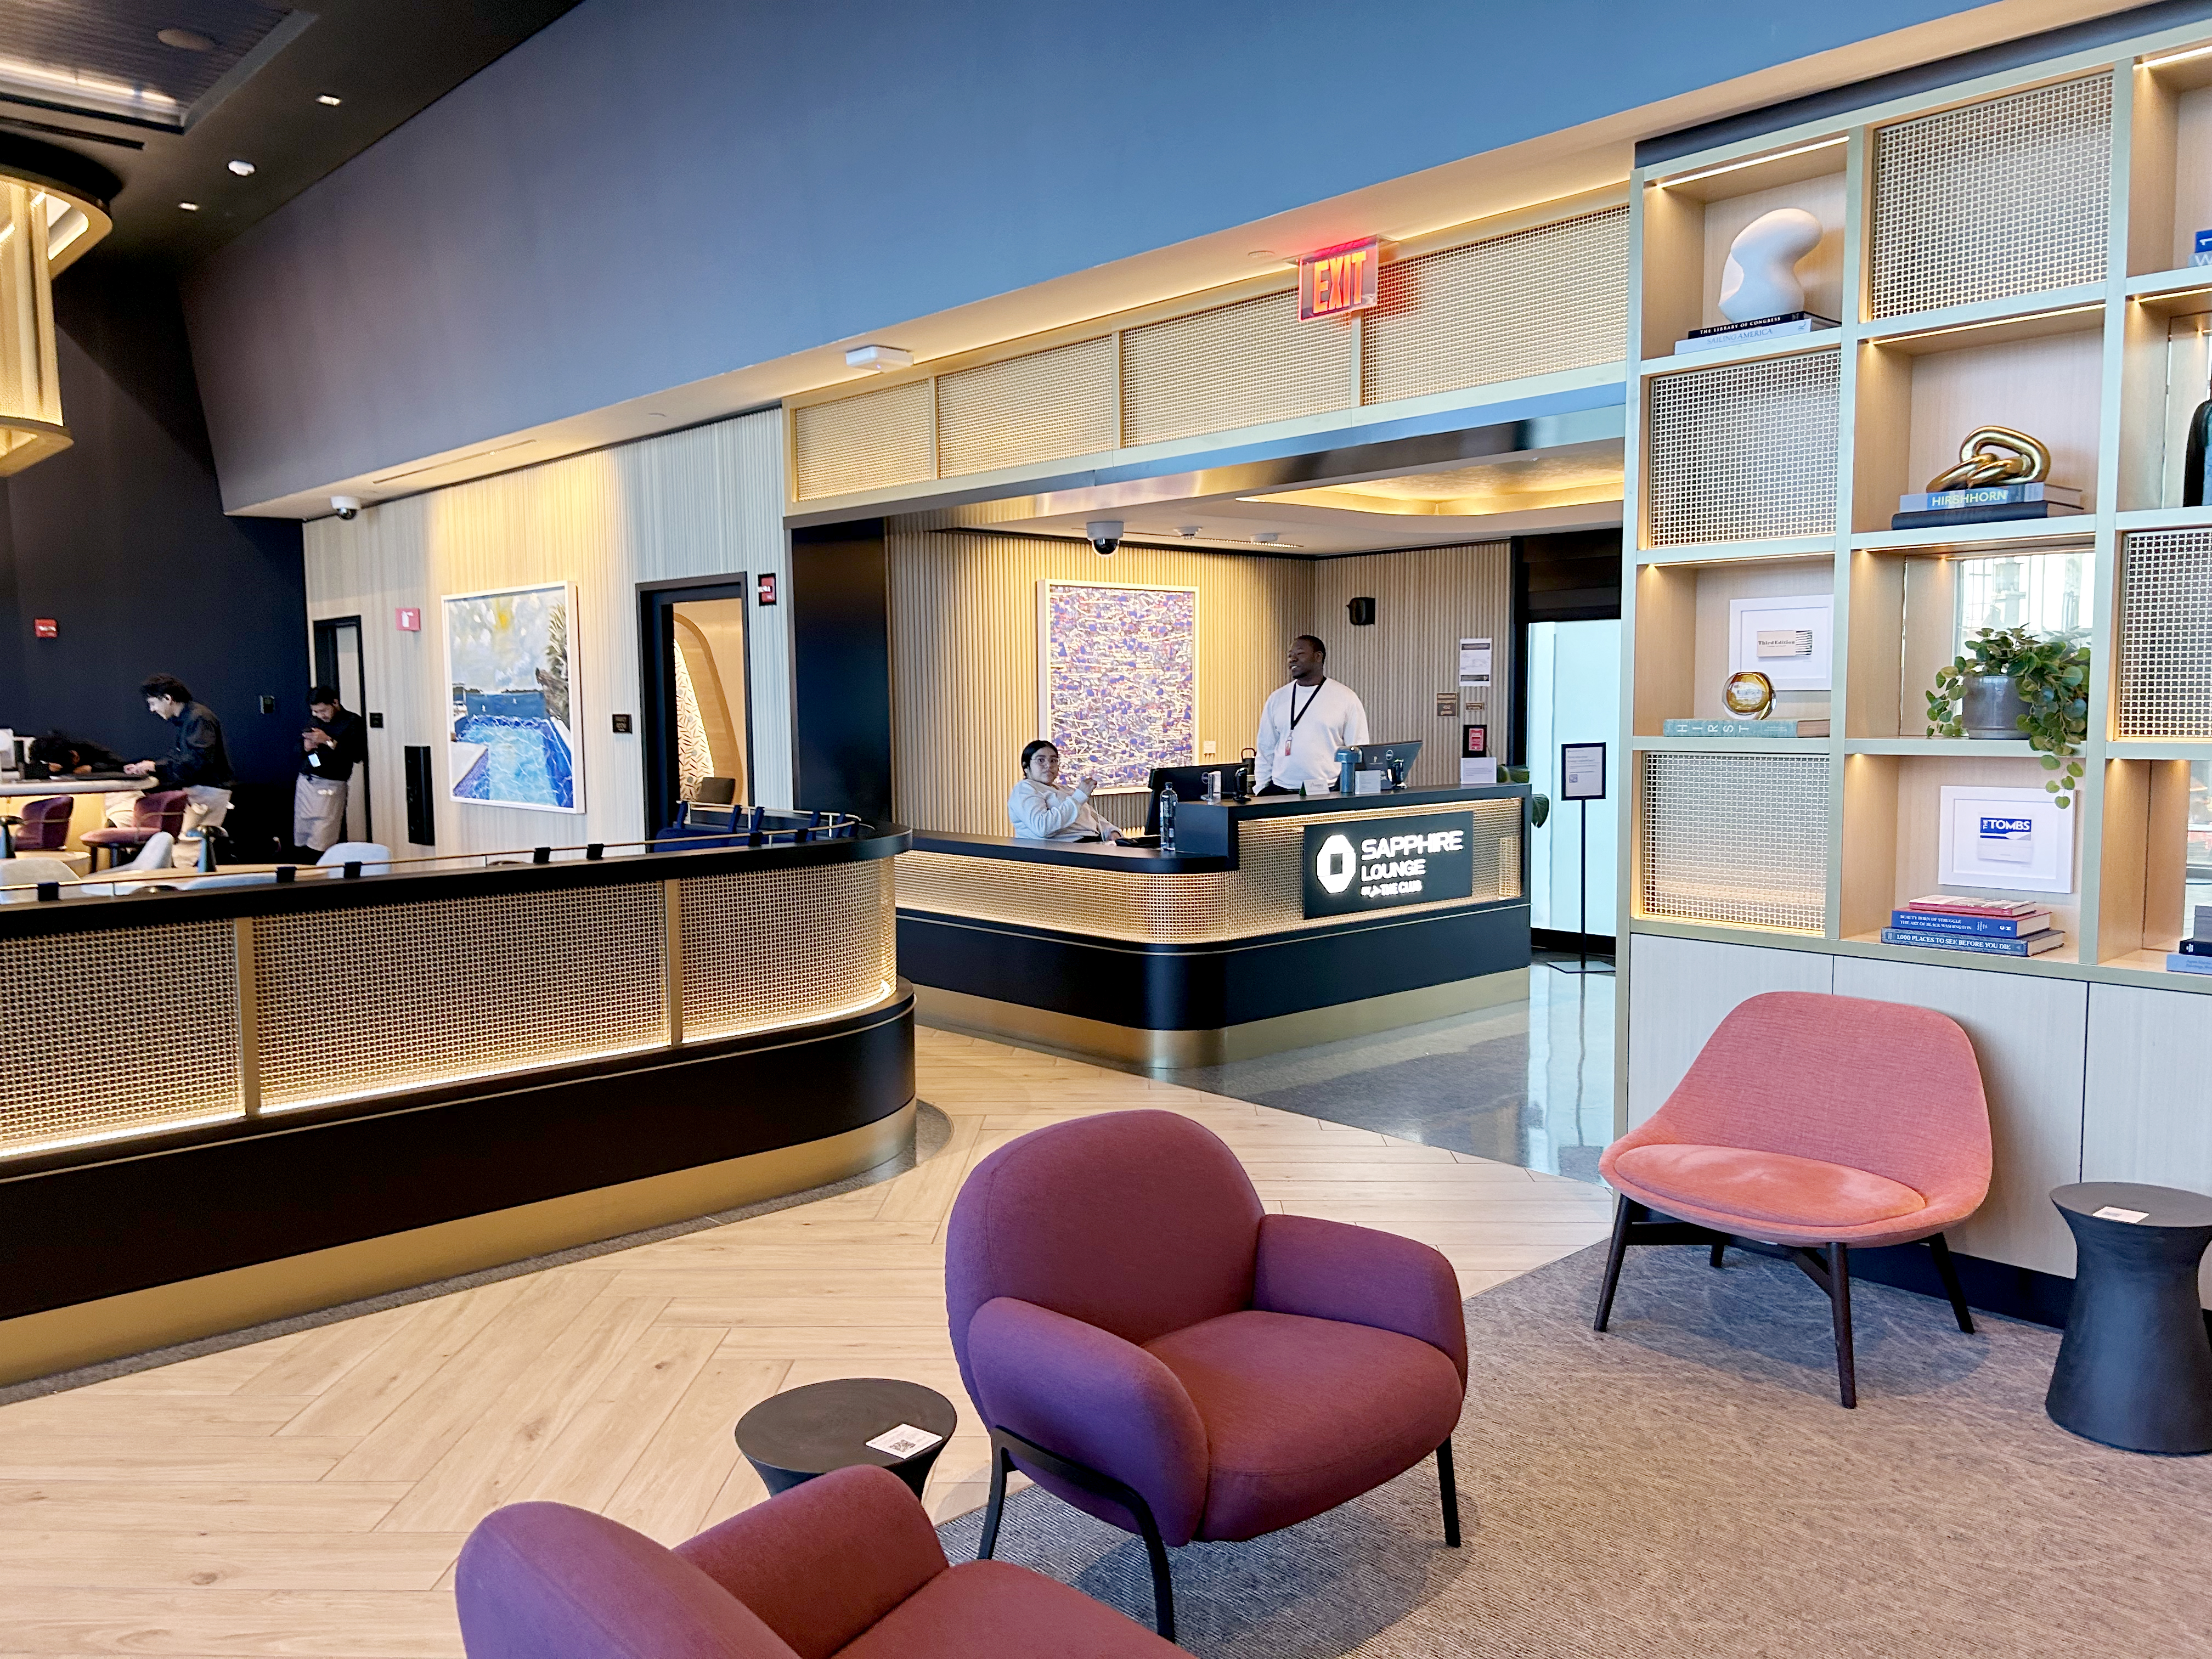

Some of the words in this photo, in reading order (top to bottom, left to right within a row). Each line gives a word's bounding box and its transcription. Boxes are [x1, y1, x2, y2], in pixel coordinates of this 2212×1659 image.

[1313, 250, 1367, 314] EXIT
[1713, 324, 1739, 332] LIBRARY
[1750, 317, 1781, 326] CONGRESS
[1707, 334, 1737, 345] SAILING
[1738, 328, 1773, 339] AMERICA
[1932, 490, 2008, 506] HIRSHHORN
[1677, 724, 1750, 733] HIRST
[1988, 820, 2030, 831] TOMBS
[1361, 830, 1464, 861] SAPPHIRE
[1361, 859, 1426, 882] LOUNGE
[1380, 882, 1398, 896] THE
[1398, 879, 1422, 894] CLUB
